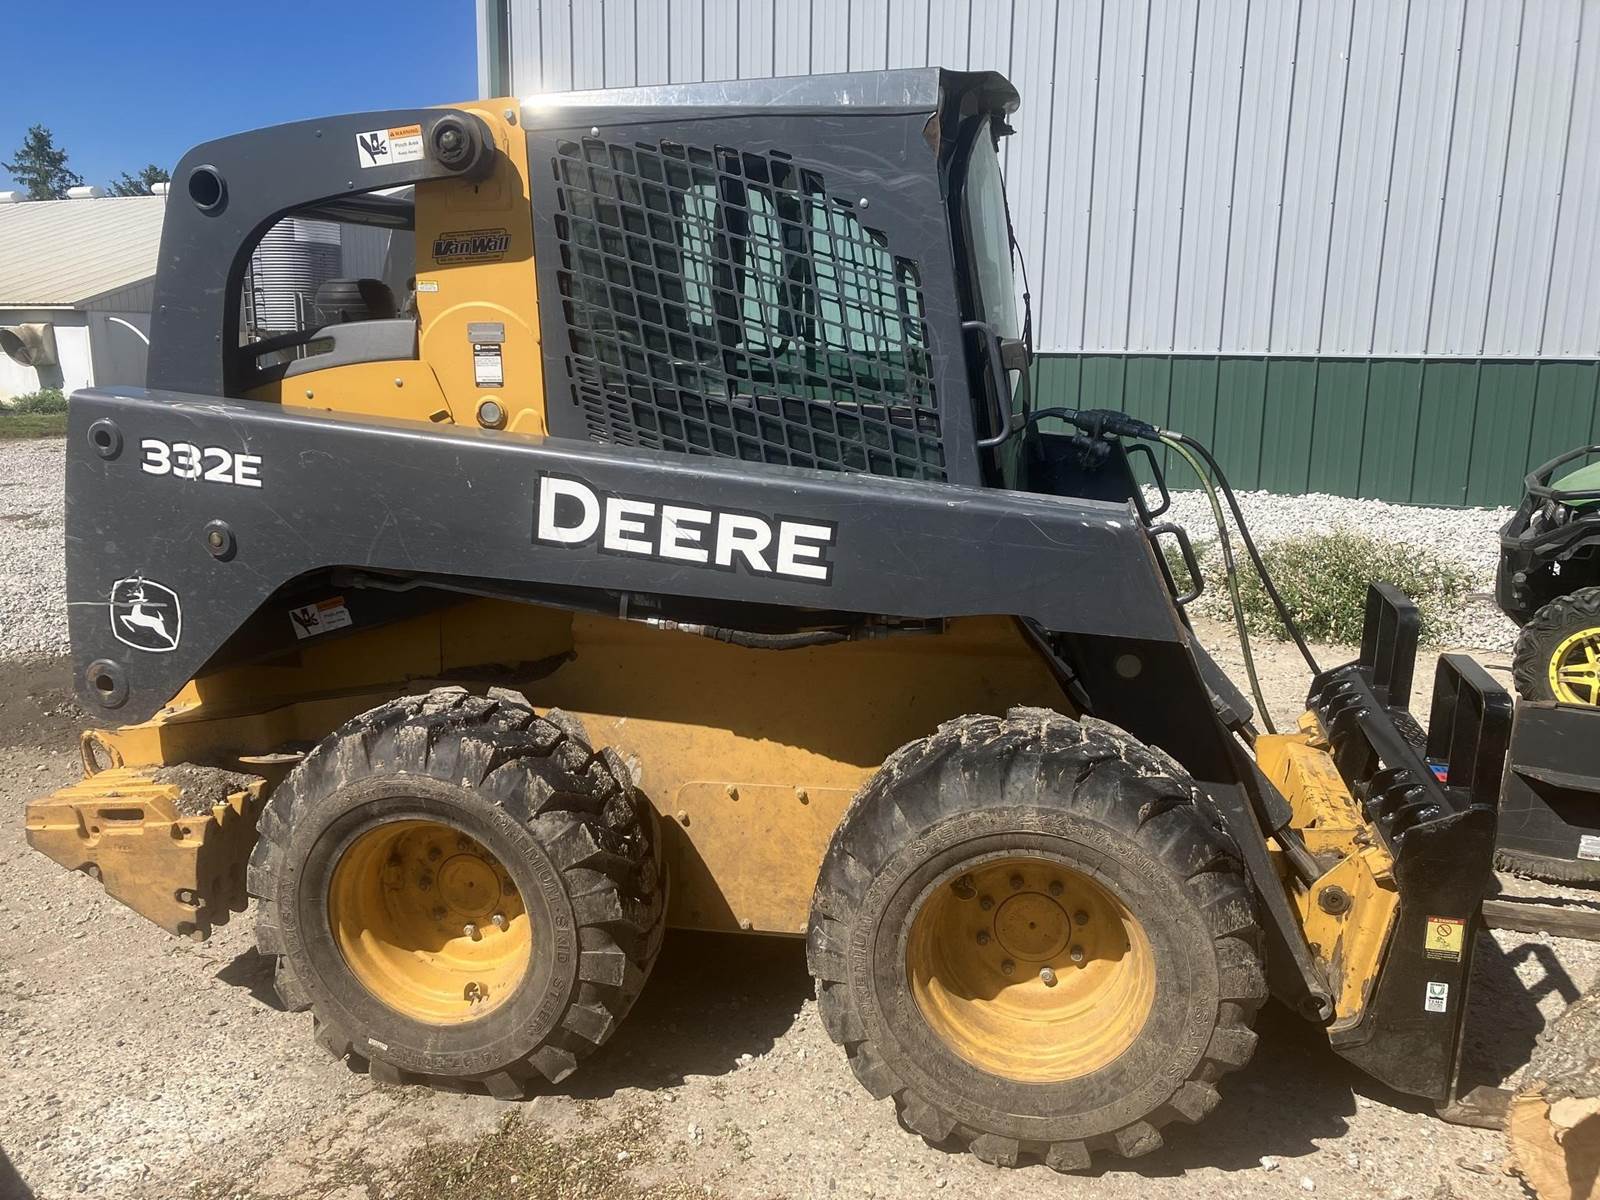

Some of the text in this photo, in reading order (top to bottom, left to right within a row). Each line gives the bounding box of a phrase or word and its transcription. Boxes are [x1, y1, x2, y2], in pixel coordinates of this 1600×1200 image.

[394, 128, 419, 136] WARNING
[141, 440, 262, 487] 332E
[538, 476, 832, 579] DEERE
